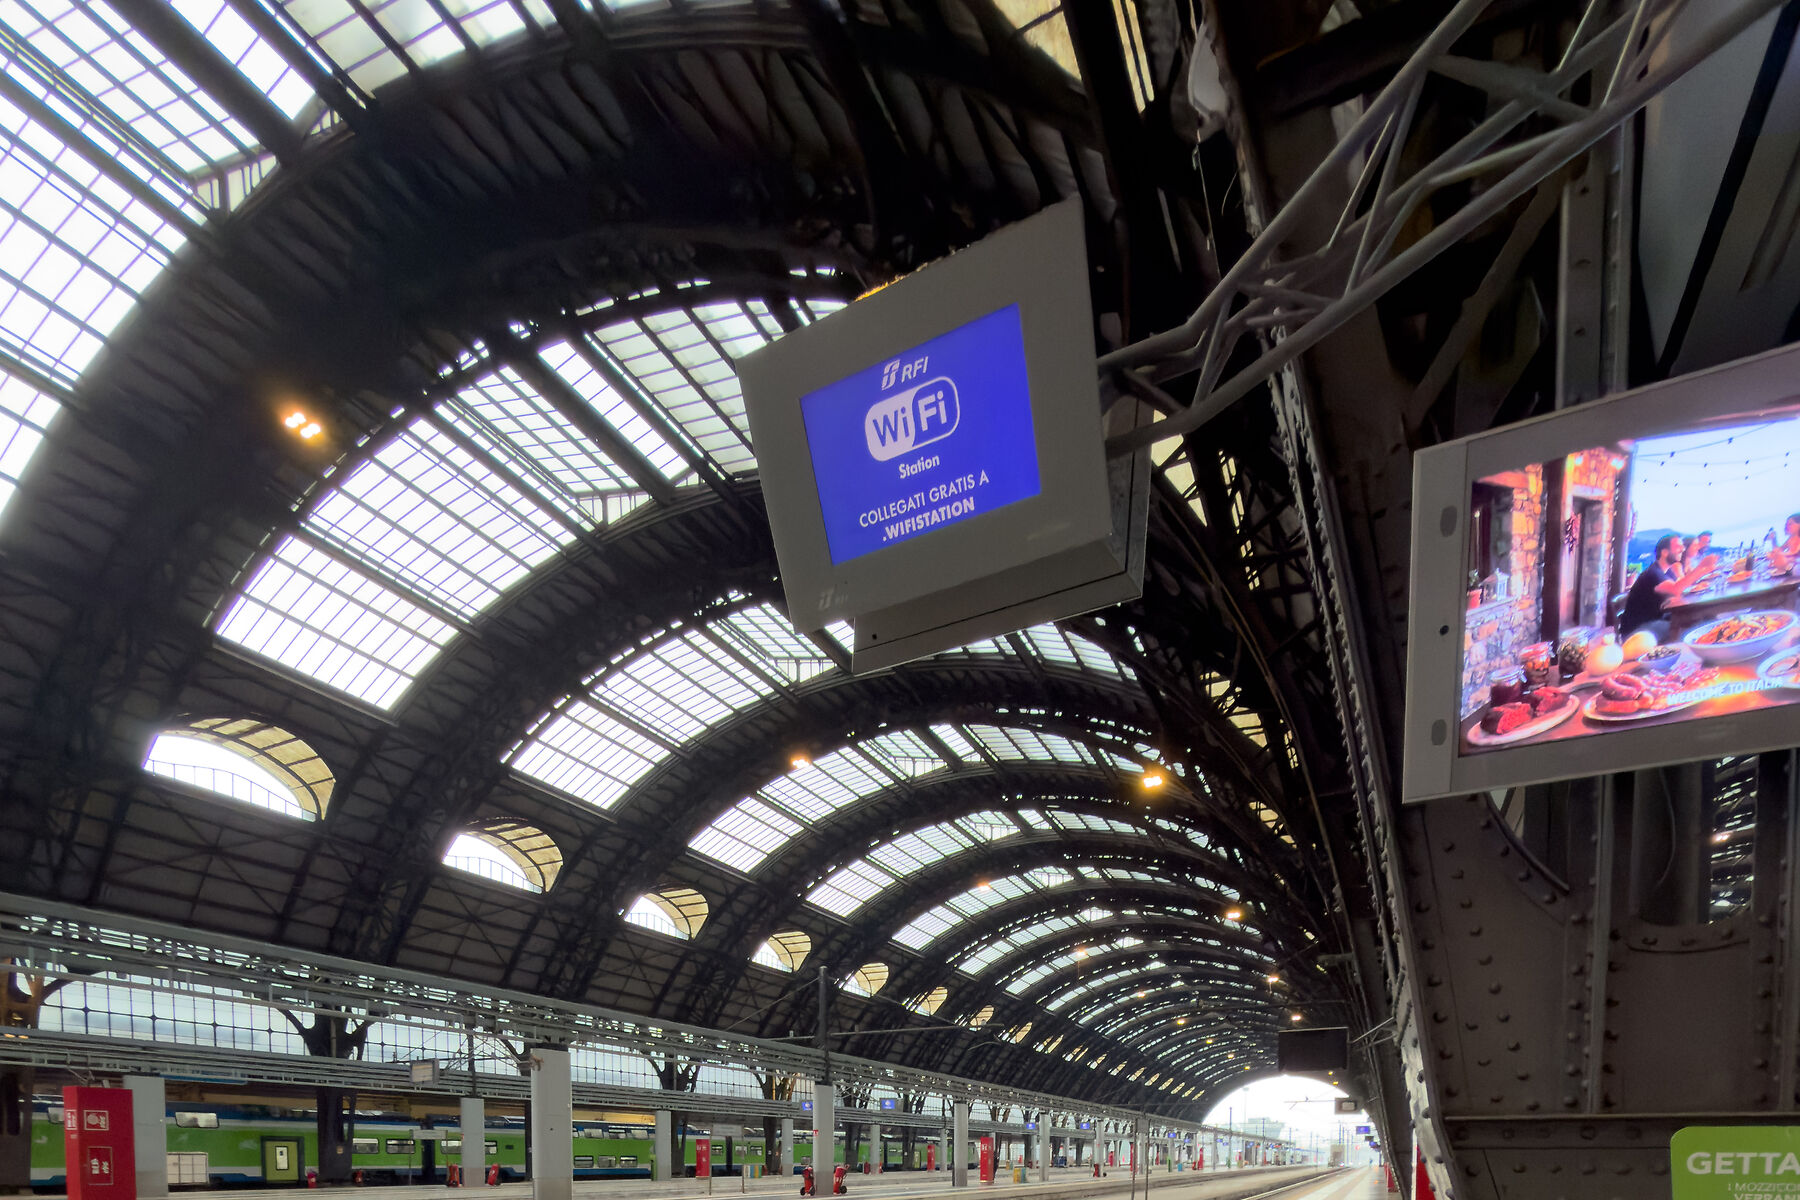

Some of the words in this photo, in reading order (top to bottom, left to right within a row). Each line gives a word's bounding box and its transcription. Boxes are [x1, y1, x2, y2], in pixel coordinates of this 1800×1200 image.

[901, 356, 929, 383] RFI
[872, 390, 947, 448] WiFi
[898, 455, 940, 479] Station
[859, 491, 926, 528] COLLEGATI
[929, 473, 976, 502] GRATIS
[979, 469, 990, 485] A
[882, 496, 976, 541] .WIFISTATION
[1686, 1151, 1800, 1175] GETTA
